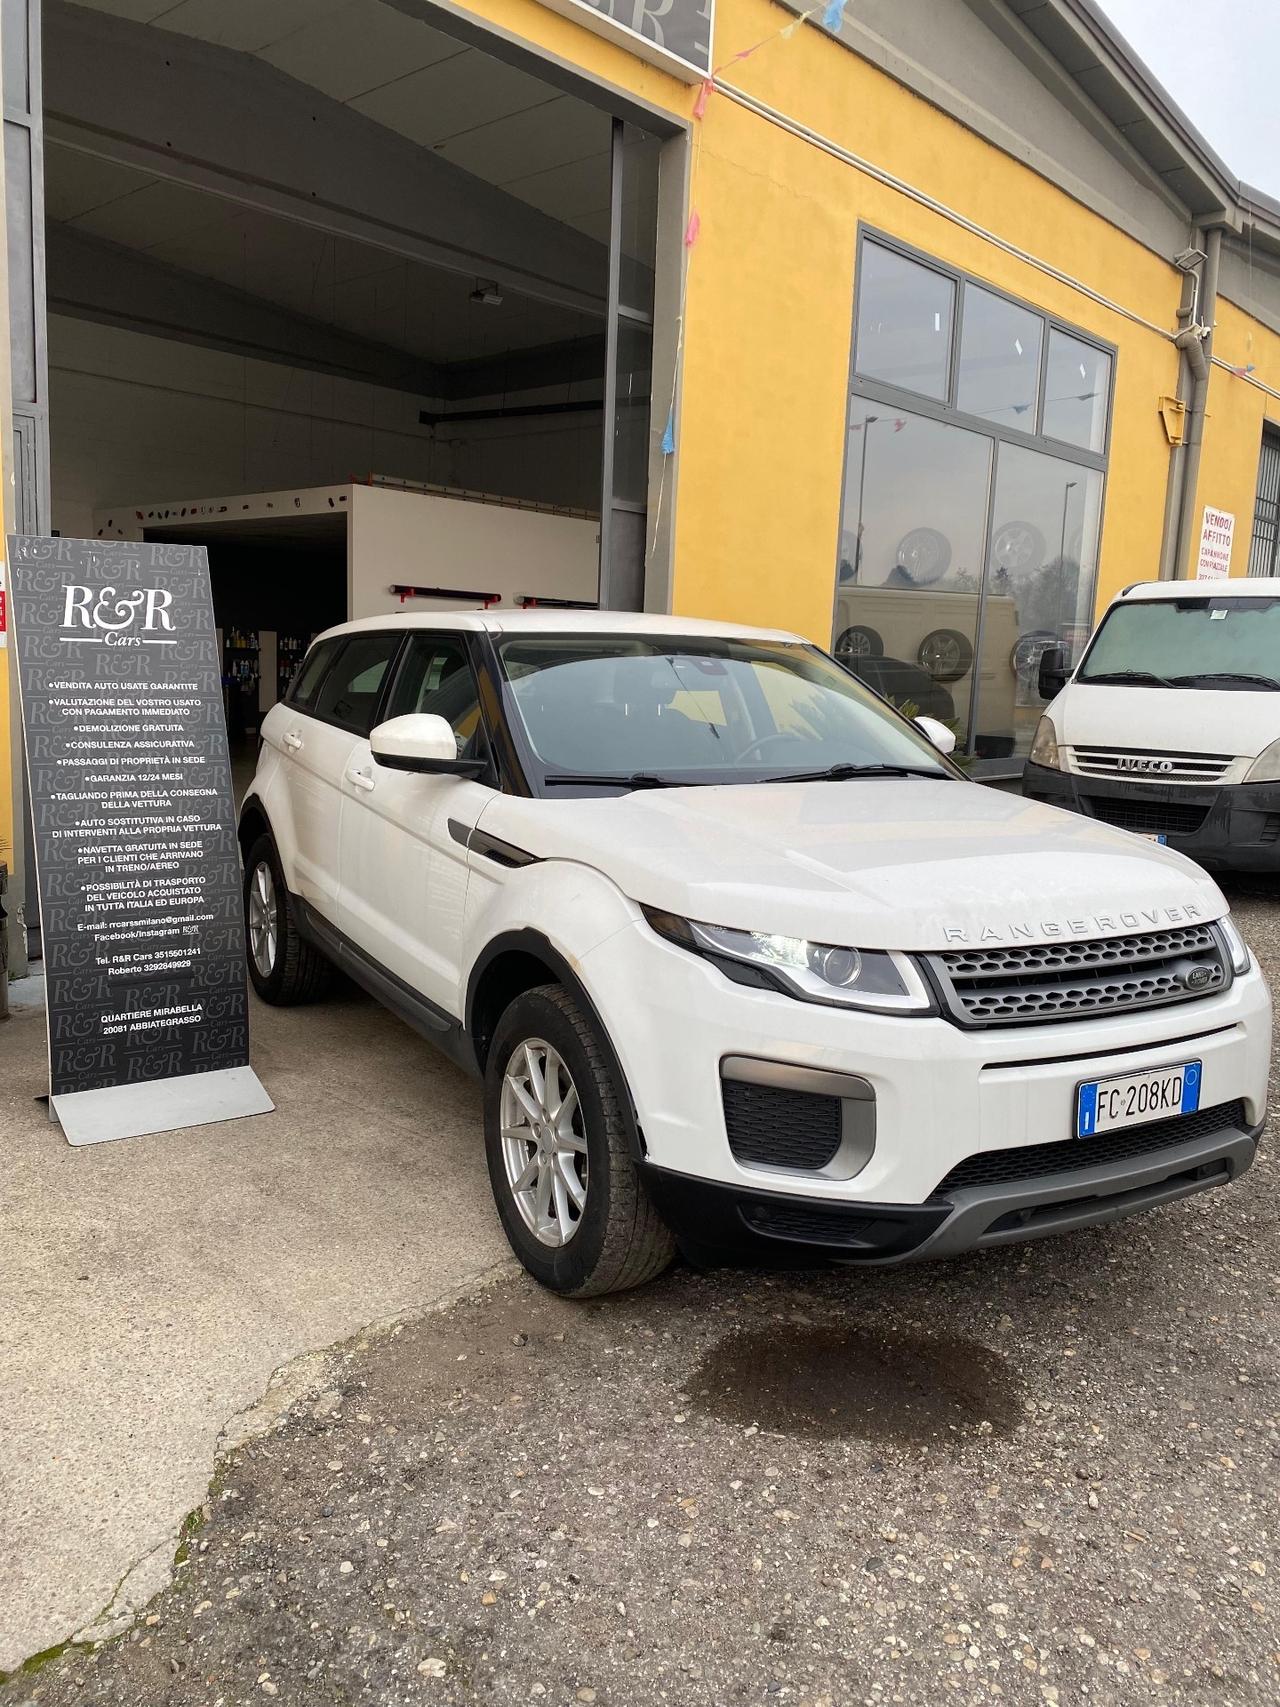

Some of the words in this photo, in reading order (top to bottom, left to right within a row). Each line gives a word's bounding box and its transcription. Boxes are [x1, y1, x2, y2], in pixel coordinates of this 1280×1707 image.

[1203, 529, 1230, 546] AFFITTO
[59, 585, 176, 630] R&R
[105, 632, 142, 647] Cars
[121, 755, 170, 765] PROPRIETÀ
[1117, 758, 1173, 773] IVECO
[56, 792, 108, 800] TAGLIANDO
[170, 789, 217, 797] CONSEGNA
[81, 819, 105, 827] AUTO
[107, 817, 164, 825] SOSTITUTIVA
[64, 829, 117, 837] INTERVENTI
[143, 826, 181, 834] PROPRIA
[183, 824, 222, 832] VETTURA
[83, 845, 123, 854] NAVETTA
[125, 843, 167, 852] GRATUITA
[180, 841, 202, 849] SEDE
[103, 854, 138, 863] CLIENTI
[160, 851, 203, 859] ARRIVANO
[116, 862, 179, 872] TRENO/AEREO
[86, 880, 141, 891] POSSIBILITÀ
[154, 877, 206, 886] TRASPORTO
[106, 891, 145, 900] VEICOLO
[147, 887, 201, 897] ACQUISTATO
[97, 902, 125, 911] TUTTA
[126, 900, 153, 909] ITALIA
[169, 896, 204, 906] EUROPA
[77, 922, 108, 931] E-mail:
[109, 913, 214, 928] rrcarssmilano@gmail.com
[943, 920, 1088, 943] RANGE
[1094, 904, 1201, 931] ROVER
[94, 928, 179, 941] Facebook/Instagram
[96, 957, 111, 965] Tel.
[113, 955, 131, 964] R&R
[133, 953, 153, 961] Cars
[155, 948, 201, 959] 3515501241
[108, 965, 142, 975] Roberto
[144, 960, 191, 972] 3292849929
[101, 1010, 152, 1023] QUARTIERE
[154, 1004, 203, 1017] MIRABELLA
[130, 1015, 201, 1031] ABBIATEGRASSO
